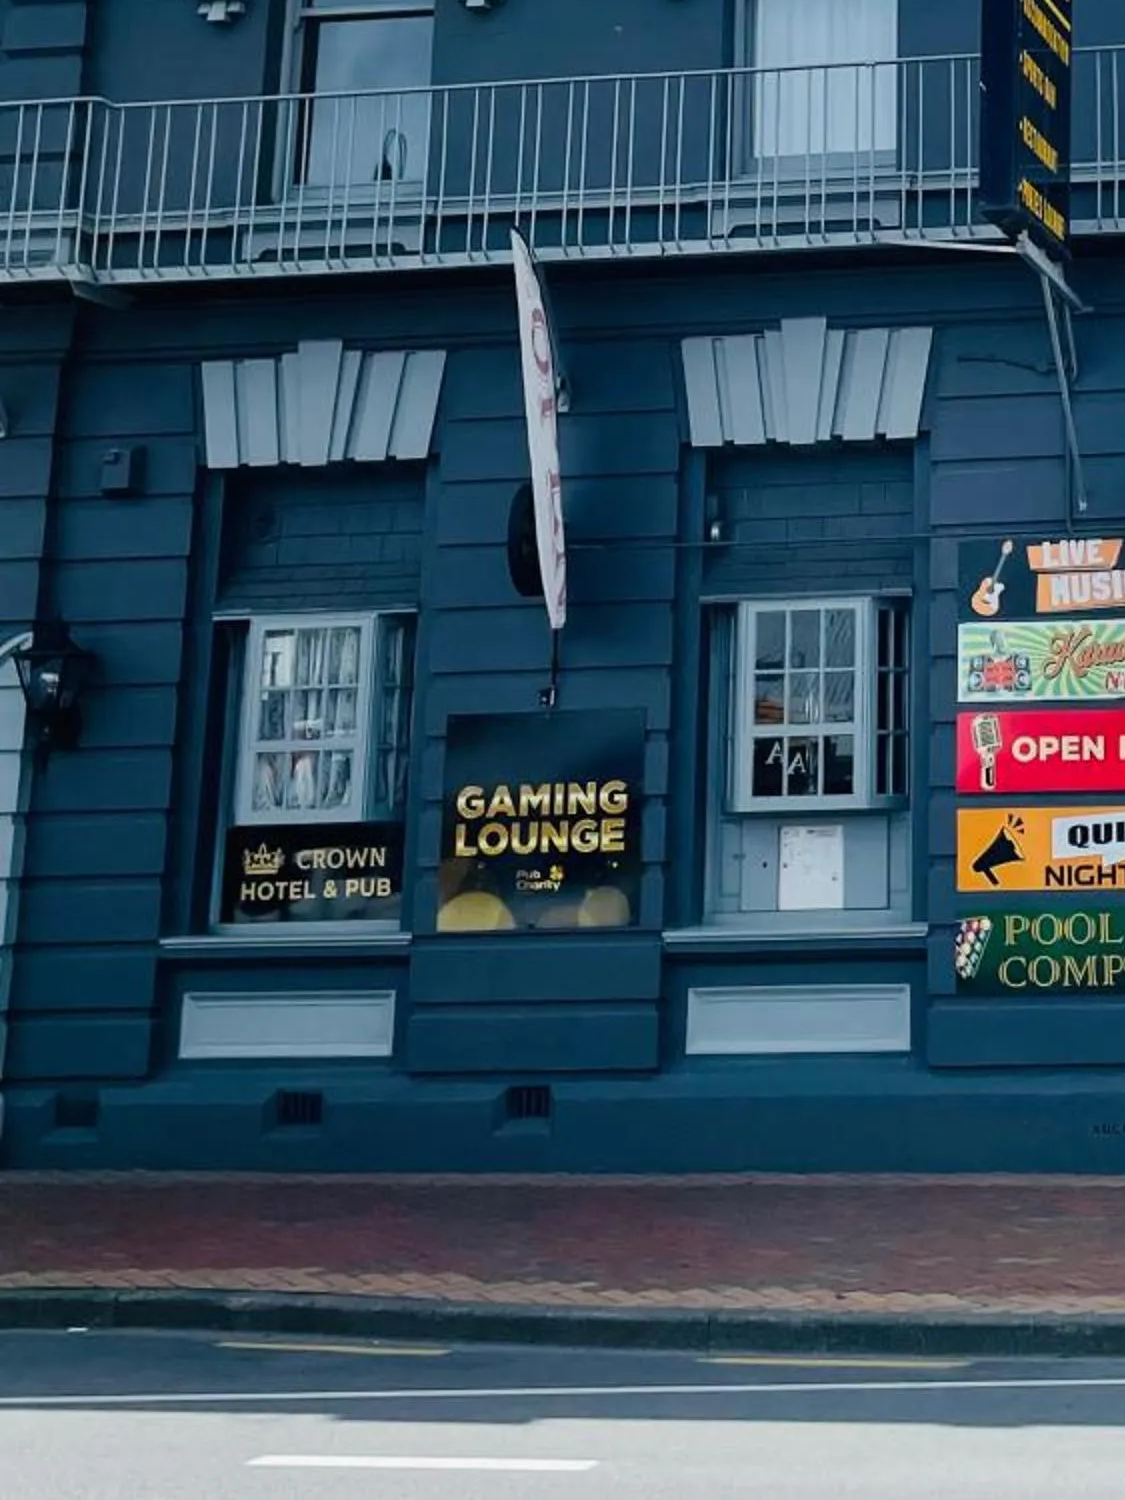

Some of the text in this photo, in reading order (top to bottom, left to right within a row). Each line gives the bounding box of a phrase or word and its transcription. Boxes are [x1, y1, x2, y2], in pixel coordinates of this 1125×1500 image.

[1041, 539, 1104, 569] LIVE
[1011, 735, 1105, 763] OPEN
[456, 779, 628, 820] GAMING
[455, 818, 626, 857] LOUNGE
[296, 847, 386, 870] CROWN
[516, 869, 541, 880] Pub
[516, 879, 561, 892] Charity
[240, 877, 391, 901] HOTEL & PUB
[1004, 912, 1124, 946] POOL
